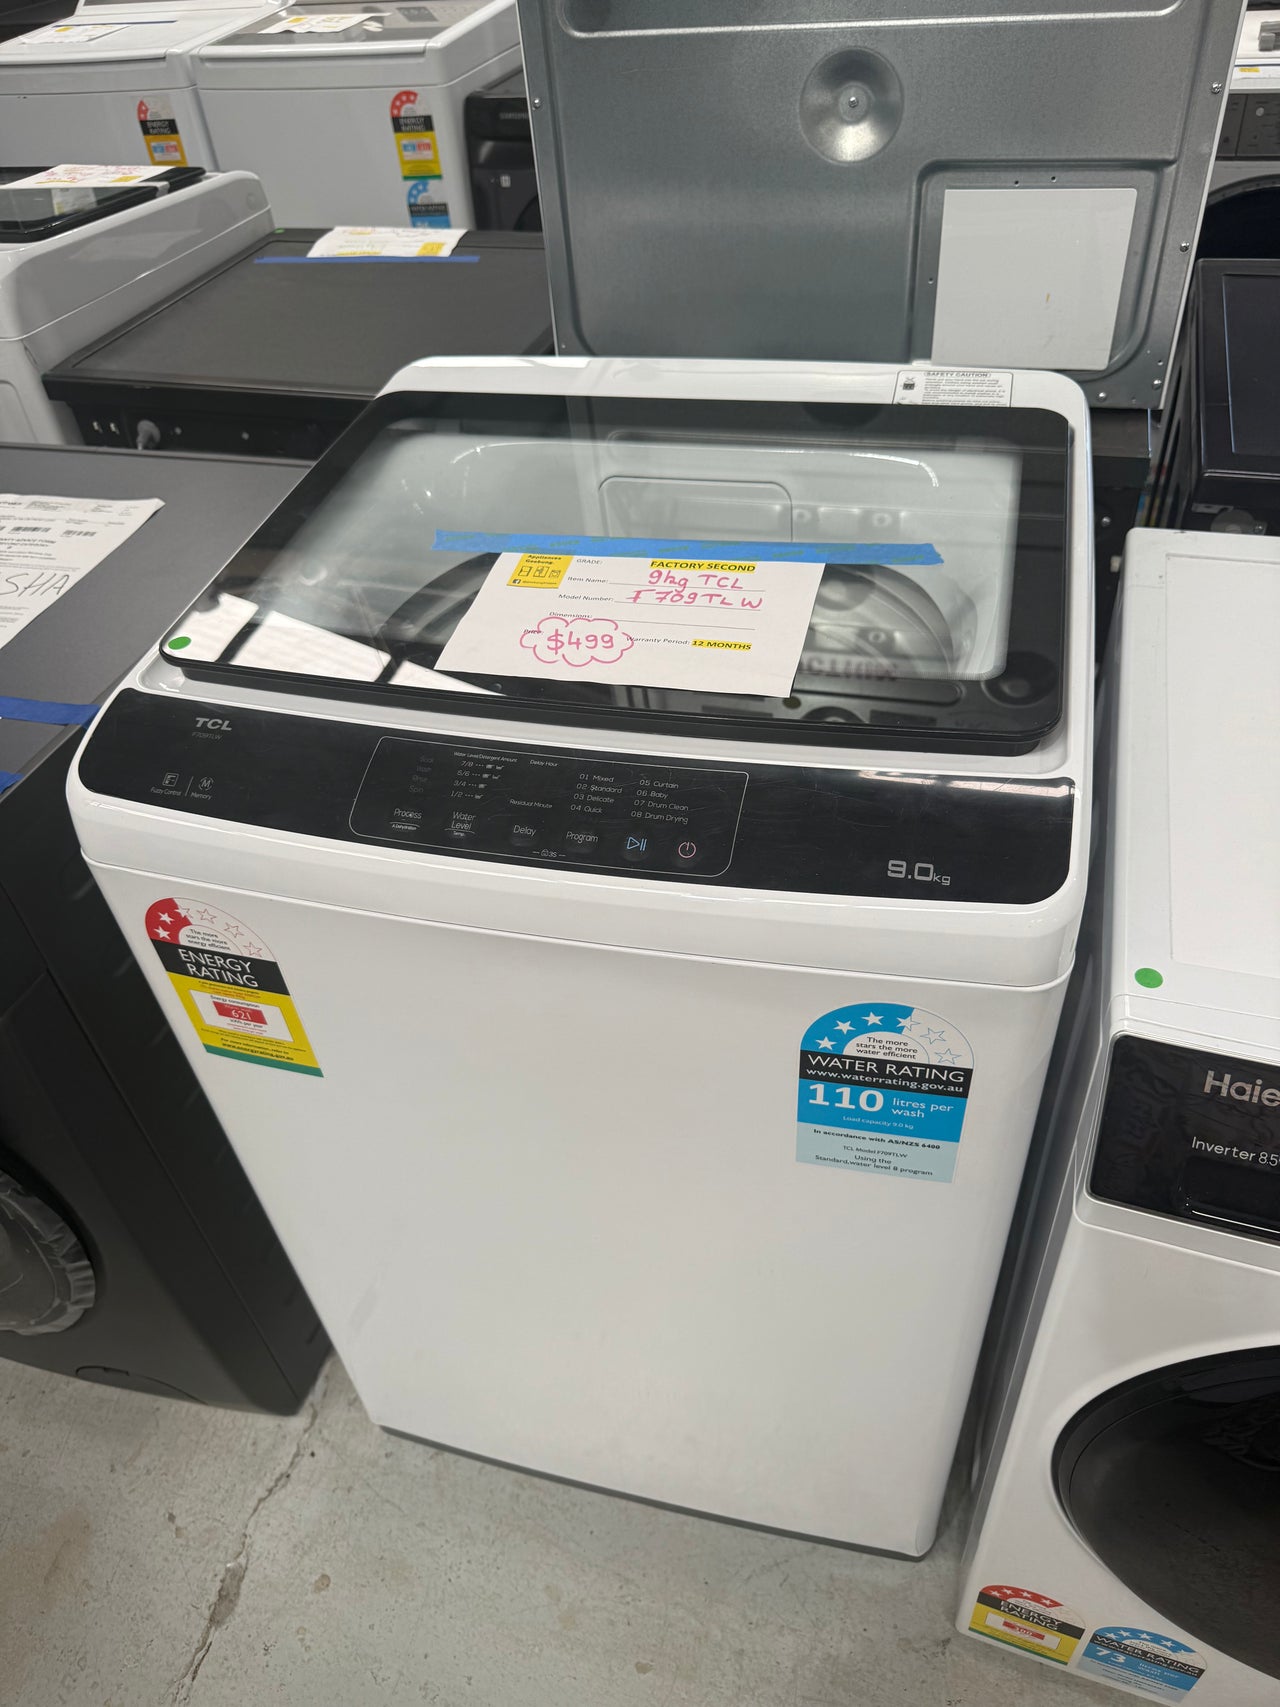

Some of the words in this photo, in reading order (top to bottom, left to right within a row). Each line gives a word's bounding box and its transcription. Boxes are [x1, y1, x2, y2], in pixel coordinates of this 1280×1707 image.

[650, 560, 704, 569] FACTORY
[708, 562, 756, 572] SECOND
[698, 574, 744, 590] TCL
[547, 628, 614, 655] $499
[626, 636, 662, 644] Warranty
[706, 641, 752, 650] MONTHS
[195, 717, 232, 730] TCL
[590, 785, 622, 793] Standard
[653, 781, 679, 789] Curtain
[151, 787, 164, 795] Fuzzy
[164, 788, 181, 796] Control
[190, 792, 212, 800] Memory
[650, 791, 668, 799] Baby
[587, 795, 615, 803] Delicate
[394, 808, 422, 819] Process
[453, 811, 476, 820] Water
[584, 806, 602, 814] Quick
[645, 812, 664, 820] Drum
[666, 815, 688, 824] Drying
[451, 820, 472, 830] Level
[513, 825, 537, 837] Delay
[566, 831, 599, 843] Program
[178, 948, 251, 973] ENERGY
[186, 963, 258, 987] RATING
[232, 1009, 252, 1020] 621
[883, 1051, 916, 1060] efficient
[808, 1054, 878, 1074] WATER
[886, 1063, 964, 1082] RATING
[806, 1069, 963, 1093] www.waterrating.gov.au
[1203, 1070, 1280, 1107] Haie
[808, 1084, 884, 1112] 110
[893, 1098, 926, 1109] litres
[930, 1104, 954, 1112] per
[891, 1109, 925, 1118] wash
[862, 1118, 891, 1126] capacity
[823, 1130, 867, 1140] accordance
[888, 1138, 920, 1147] AS/NZS
[1192, 1136, 1255, 1162] Inverter
[1258, 1152, 1280, 1166] 8.5
[854, 1154, 877, 1163] Using
[900, 1167, 933, 1176] program
[1001, 1600, 1062, 1626] ENERGY
[1001, 1606, 1058, 1631] RATING
[1096, 1636, 1142, 1655] WATER
[1147, 1652, 1199, 1673] RATING
[1096, 1647, 1126, 1663] 73
